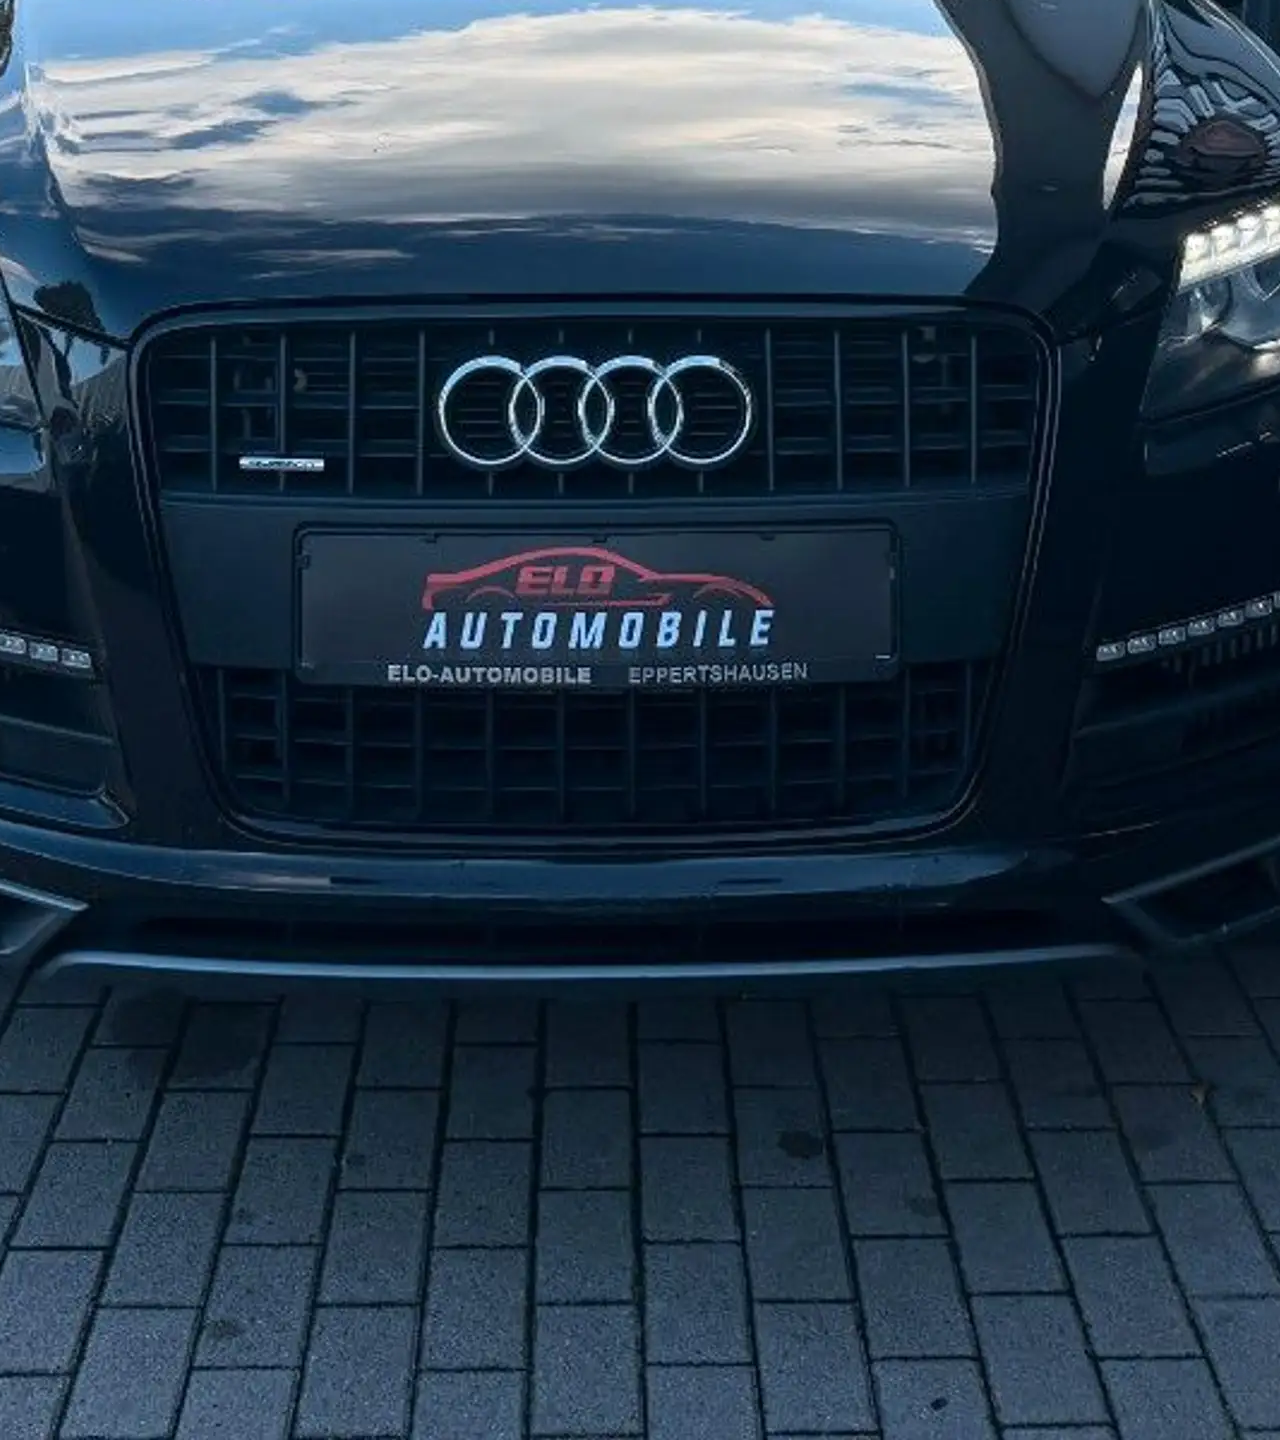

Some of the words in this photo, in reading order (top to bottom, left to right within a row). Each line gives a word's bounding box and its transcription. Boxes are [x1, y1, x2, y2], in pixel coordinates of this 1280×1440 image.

[515, 565, 615, 595] ELO
[423, 610, 775, 650] AUTOMOBILE
[387, 664, 592, 685] ELO-AUTOMOBILE
[628, 662, 808, 684] EPPERTSHAUSEN
